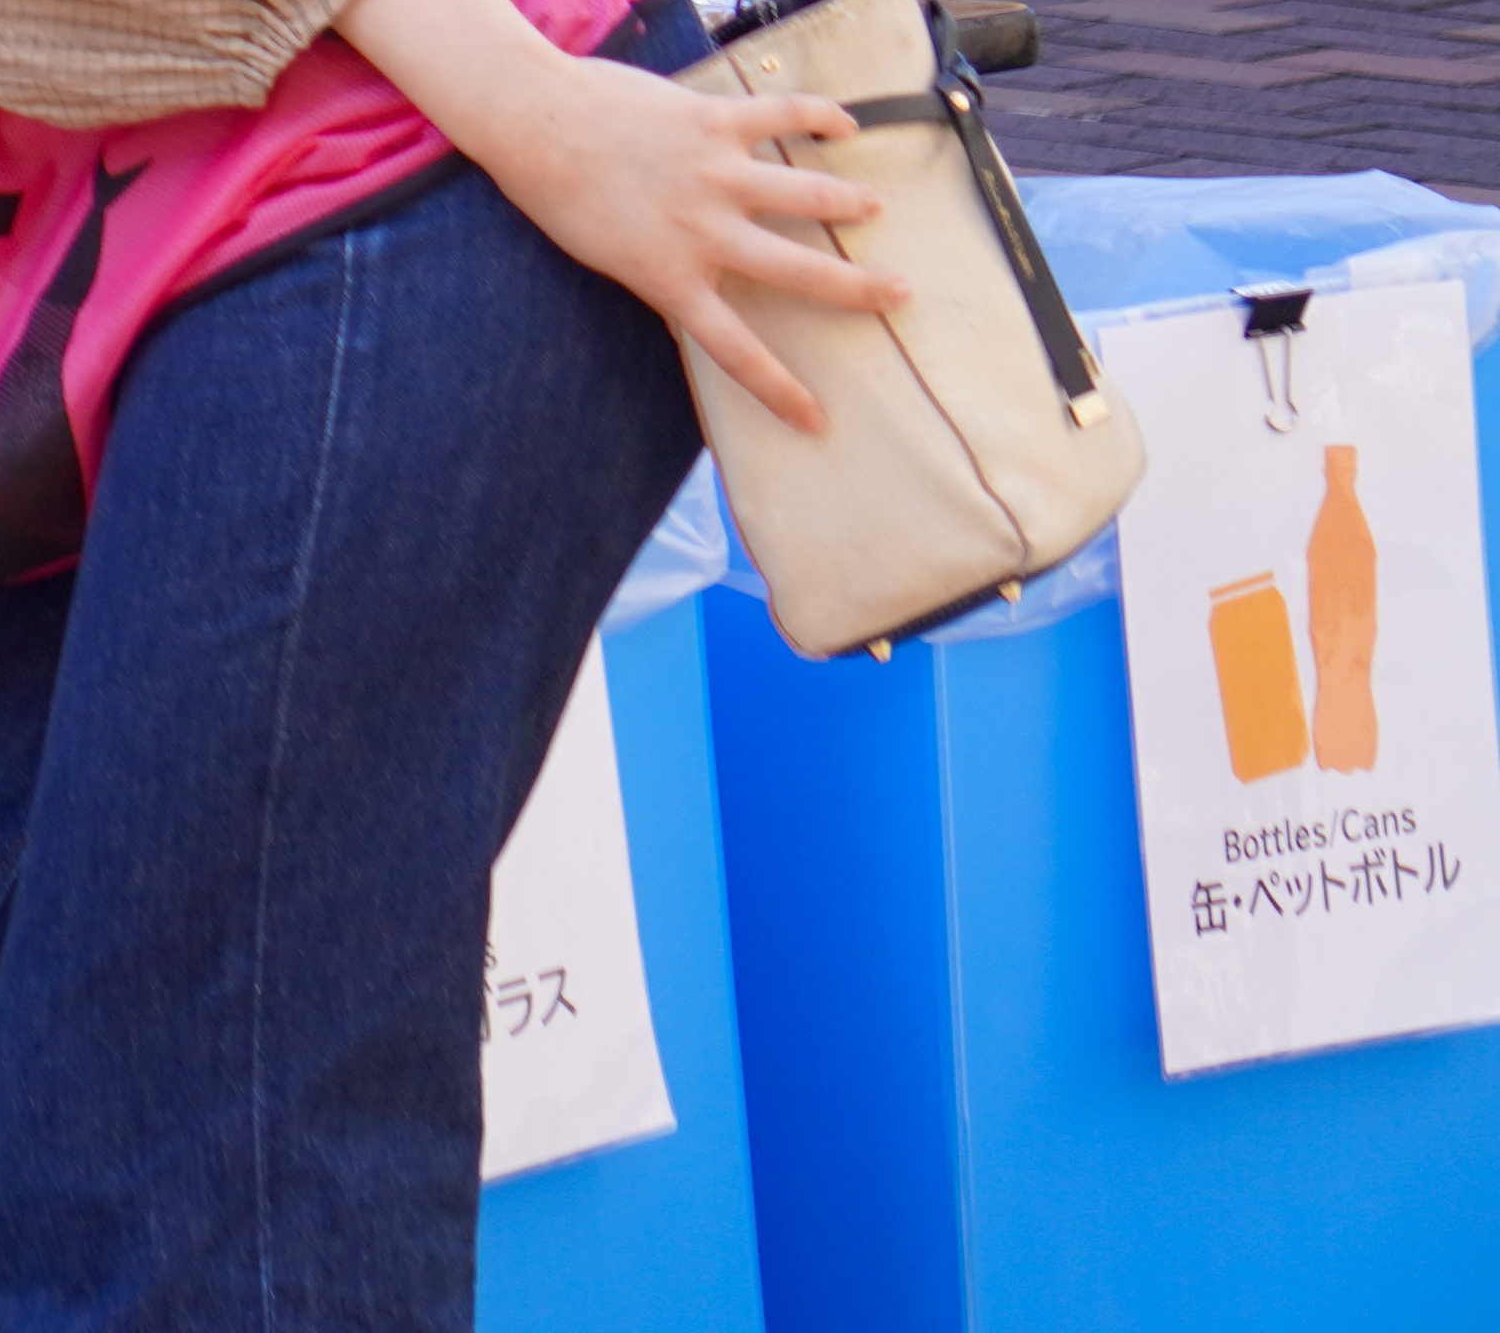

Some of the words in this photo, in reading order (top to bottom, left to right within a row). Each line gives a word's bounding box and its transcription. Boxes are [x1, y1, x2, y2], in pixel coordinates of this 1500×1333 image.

[1223, 807, 1418, 864] Bottles/Cans
[1190, 841, 1462, 939] 缶・ペットボトル
